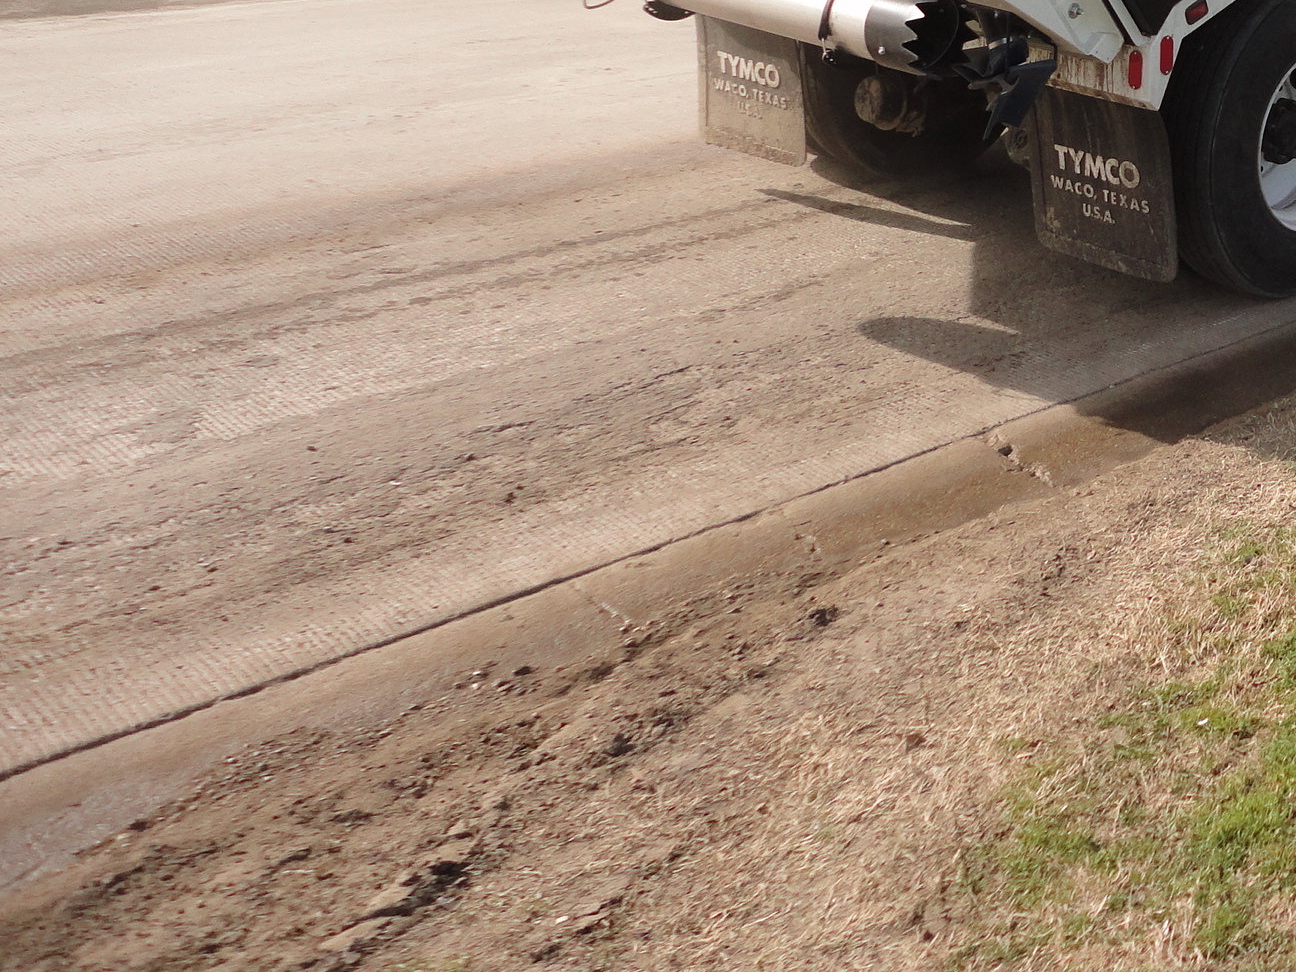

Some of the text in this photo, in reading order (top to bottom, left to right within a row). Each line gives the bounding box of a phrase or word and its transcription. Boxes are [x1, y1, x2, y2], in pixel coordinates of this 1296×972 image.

[717, 50, 780, 88] TYMCO
[752, 88, 787, 109] TEXAS
[1054, 144, 1140, 189] TYMCO
[1050, 174, 1150, 214] WACO, TEXAS
[1082, 202, 1116, 225] U.S.A.
